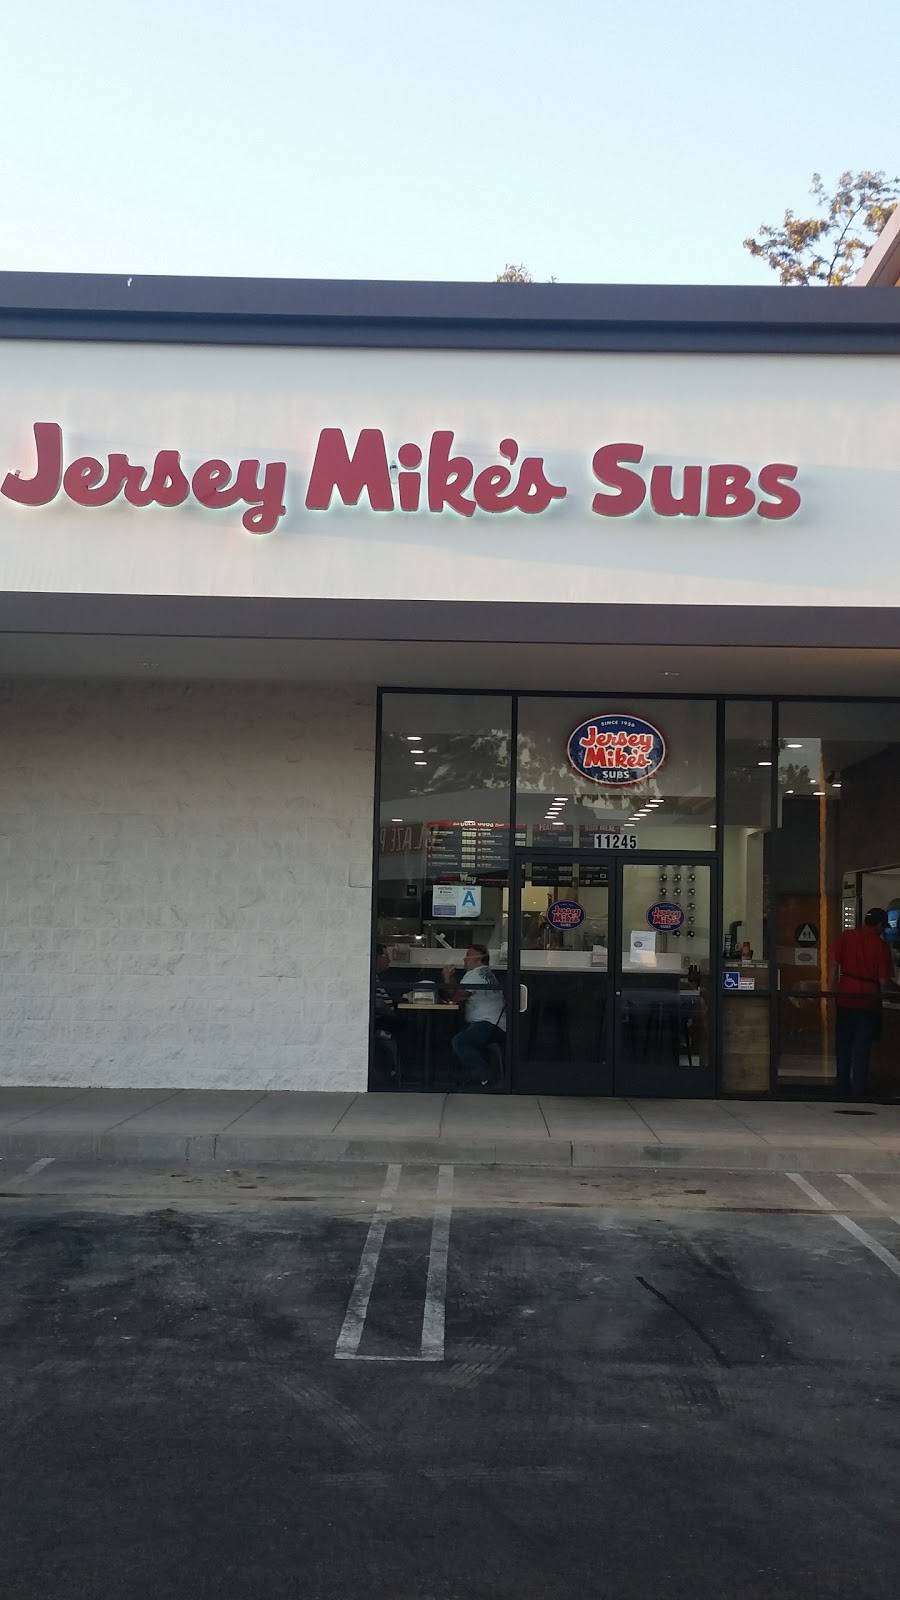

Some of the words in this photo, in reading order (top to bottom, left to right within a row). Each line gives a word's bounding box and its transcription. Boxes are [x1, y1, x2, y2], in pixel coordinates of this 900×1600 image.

[0, 422, 287, 535] Jersey
[304, 427, 567, 518] Mike's
[591, 442, 802, 520] SUBS
[579, 726, 655, 753] Jersey
[583, 746, 652, 769] Mike's
[602, 770, 630, 779] SUBS
[596, 834, 637, 849] 11245
[462, 890, 476, 907] A
